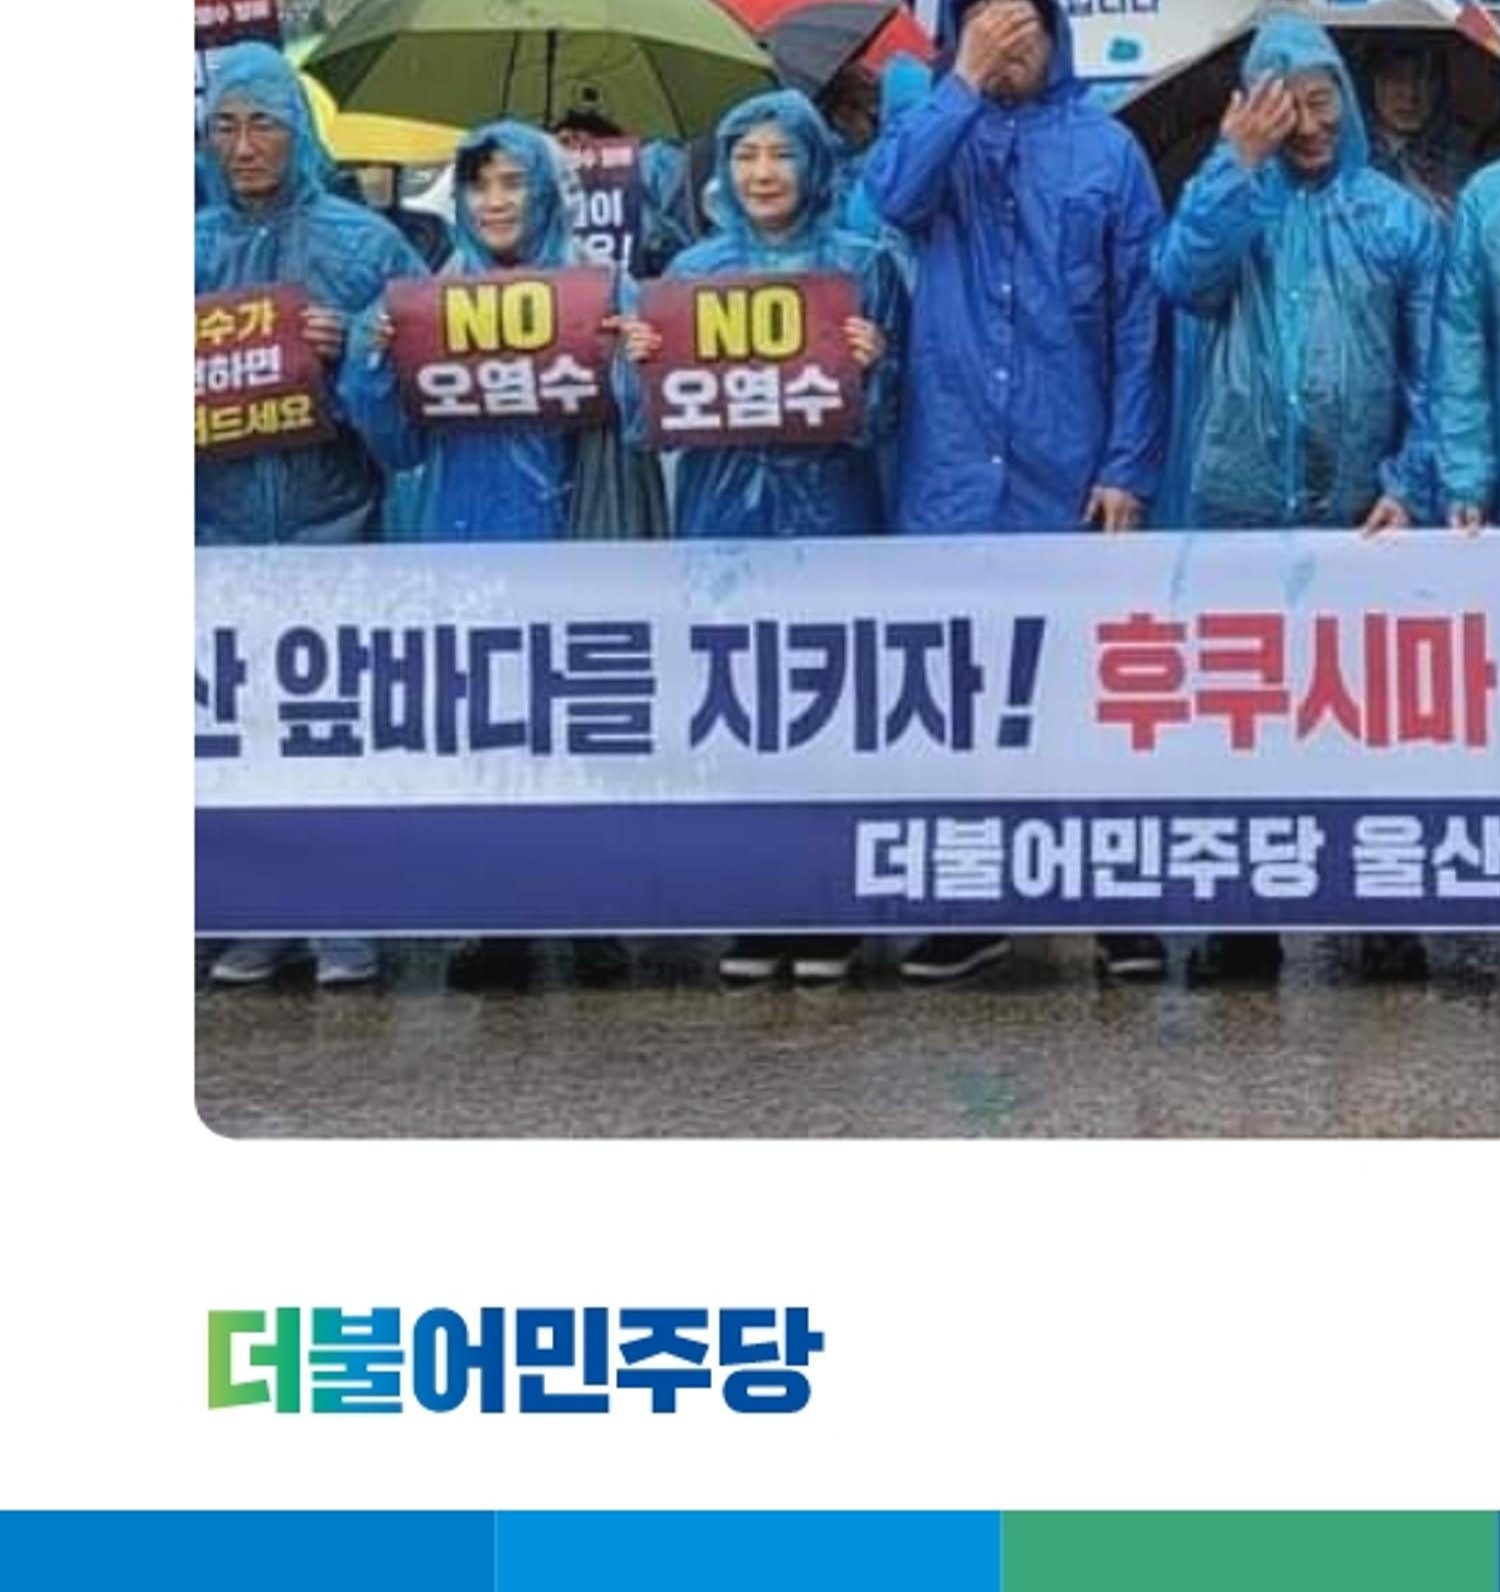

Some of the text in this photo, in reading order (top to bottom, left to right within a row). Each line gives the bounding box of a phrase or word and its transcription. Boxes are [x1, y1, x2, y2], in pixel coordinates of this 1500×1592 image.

[195, 297, 277, 346] 수가
[445, 281, 553, 353] NO
[696, 285, 802, 357] NO
[417, 355, 598, 416] 오염수
[661, 365, 842, 430] 오염수
[276, 620, 657, 758] 앞바다를
[690, 616, 1045, 753] 지키자!
[1095, 612, 1496, 751] 후쿠시마
[854, 816, 1323, 899] 더불어민주당
